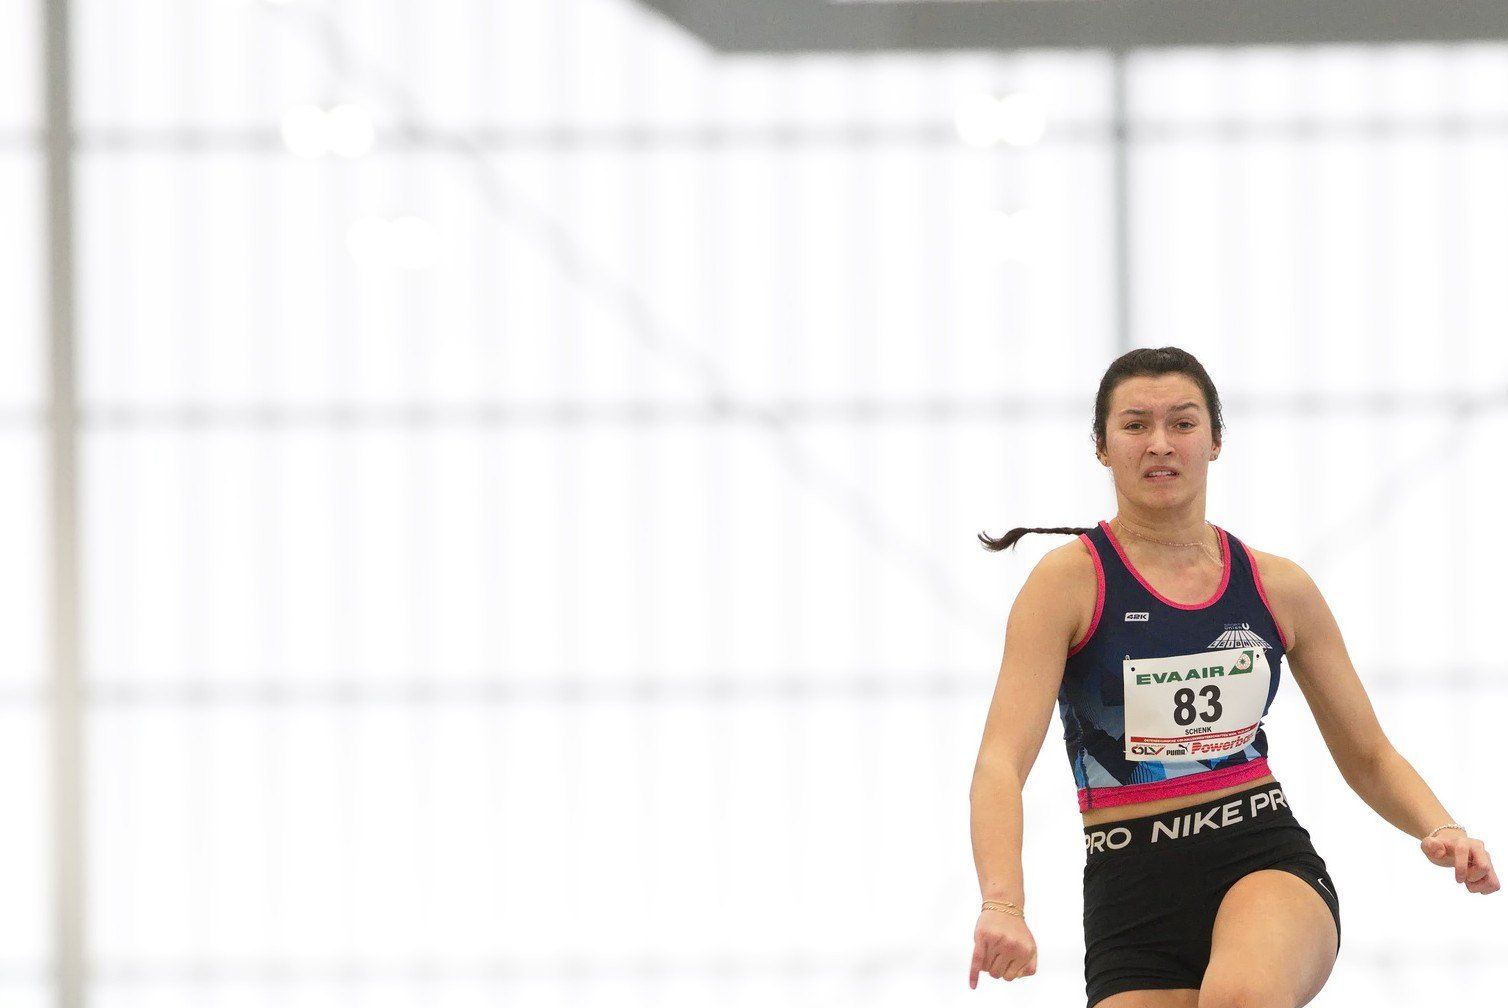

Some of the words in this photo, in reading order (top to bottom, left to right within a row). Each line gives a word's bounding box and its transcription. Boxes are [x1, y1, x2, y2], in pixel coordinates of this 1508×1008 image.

[1173, 684, 1223, 727] 83
[1185, 726, 1212, 735] SCHENK
[1151, 799, 1243, 843] NIKE
[1250, 788, 1288, 818] PR
